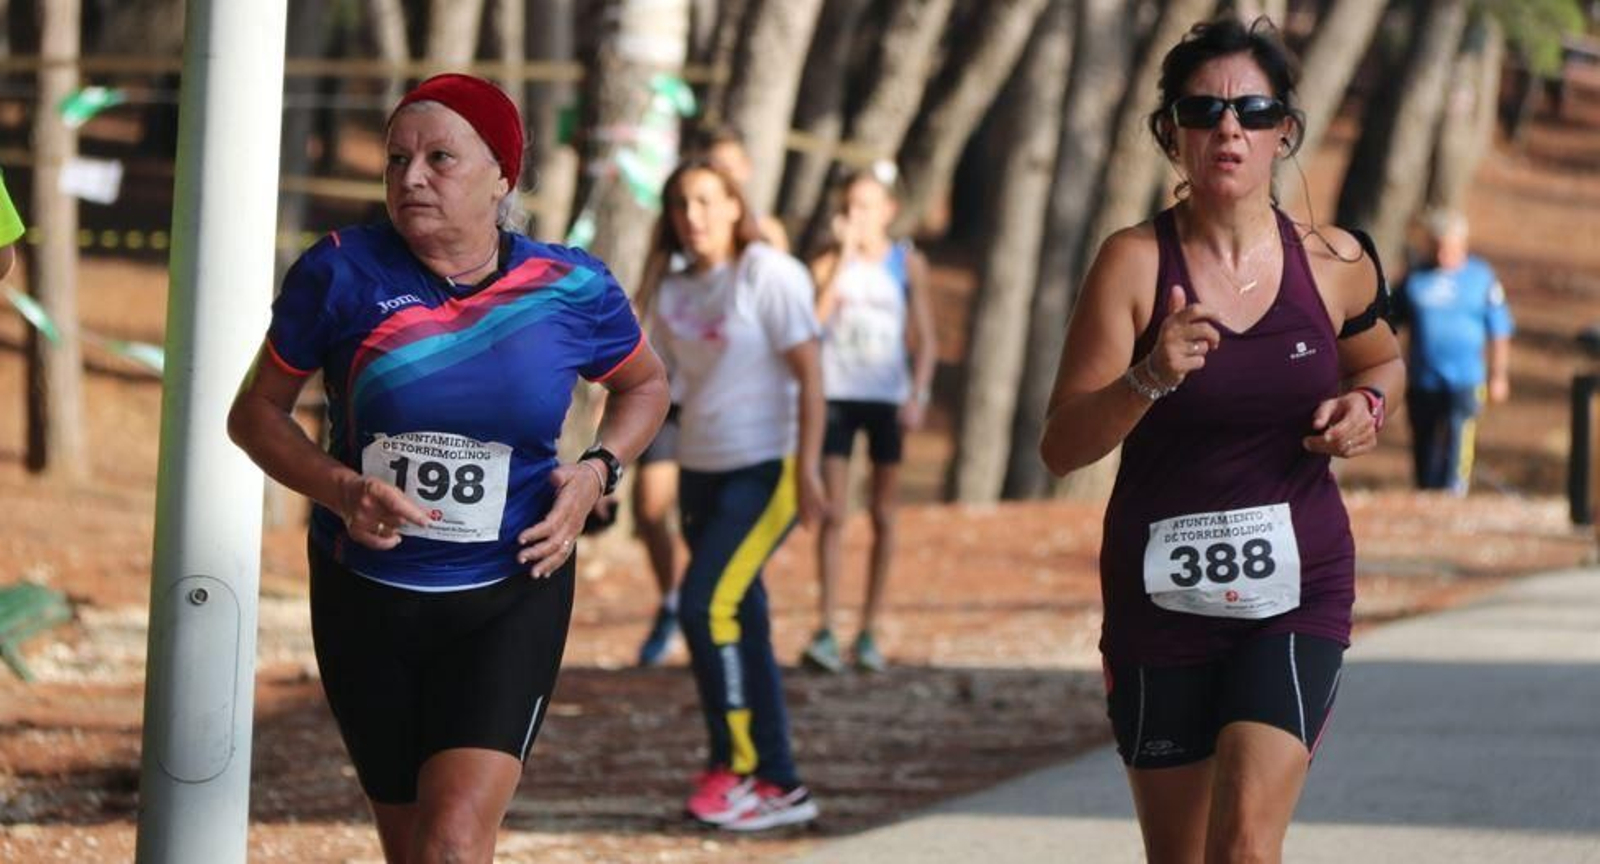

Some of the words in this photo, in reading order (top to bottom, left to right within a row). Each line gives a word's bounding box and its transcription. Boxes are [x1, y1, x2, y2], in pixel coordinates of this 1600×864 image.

[400, 442, 491, 460] TORREMOLINOS
[389, 456, 485, 504] 198
[1172, 511, 1264, 530] AYUNTAMIENTO
[1180, 522, 1273, 541] TORREMOLINOS
[1170, 538, 1276, 587] 388
